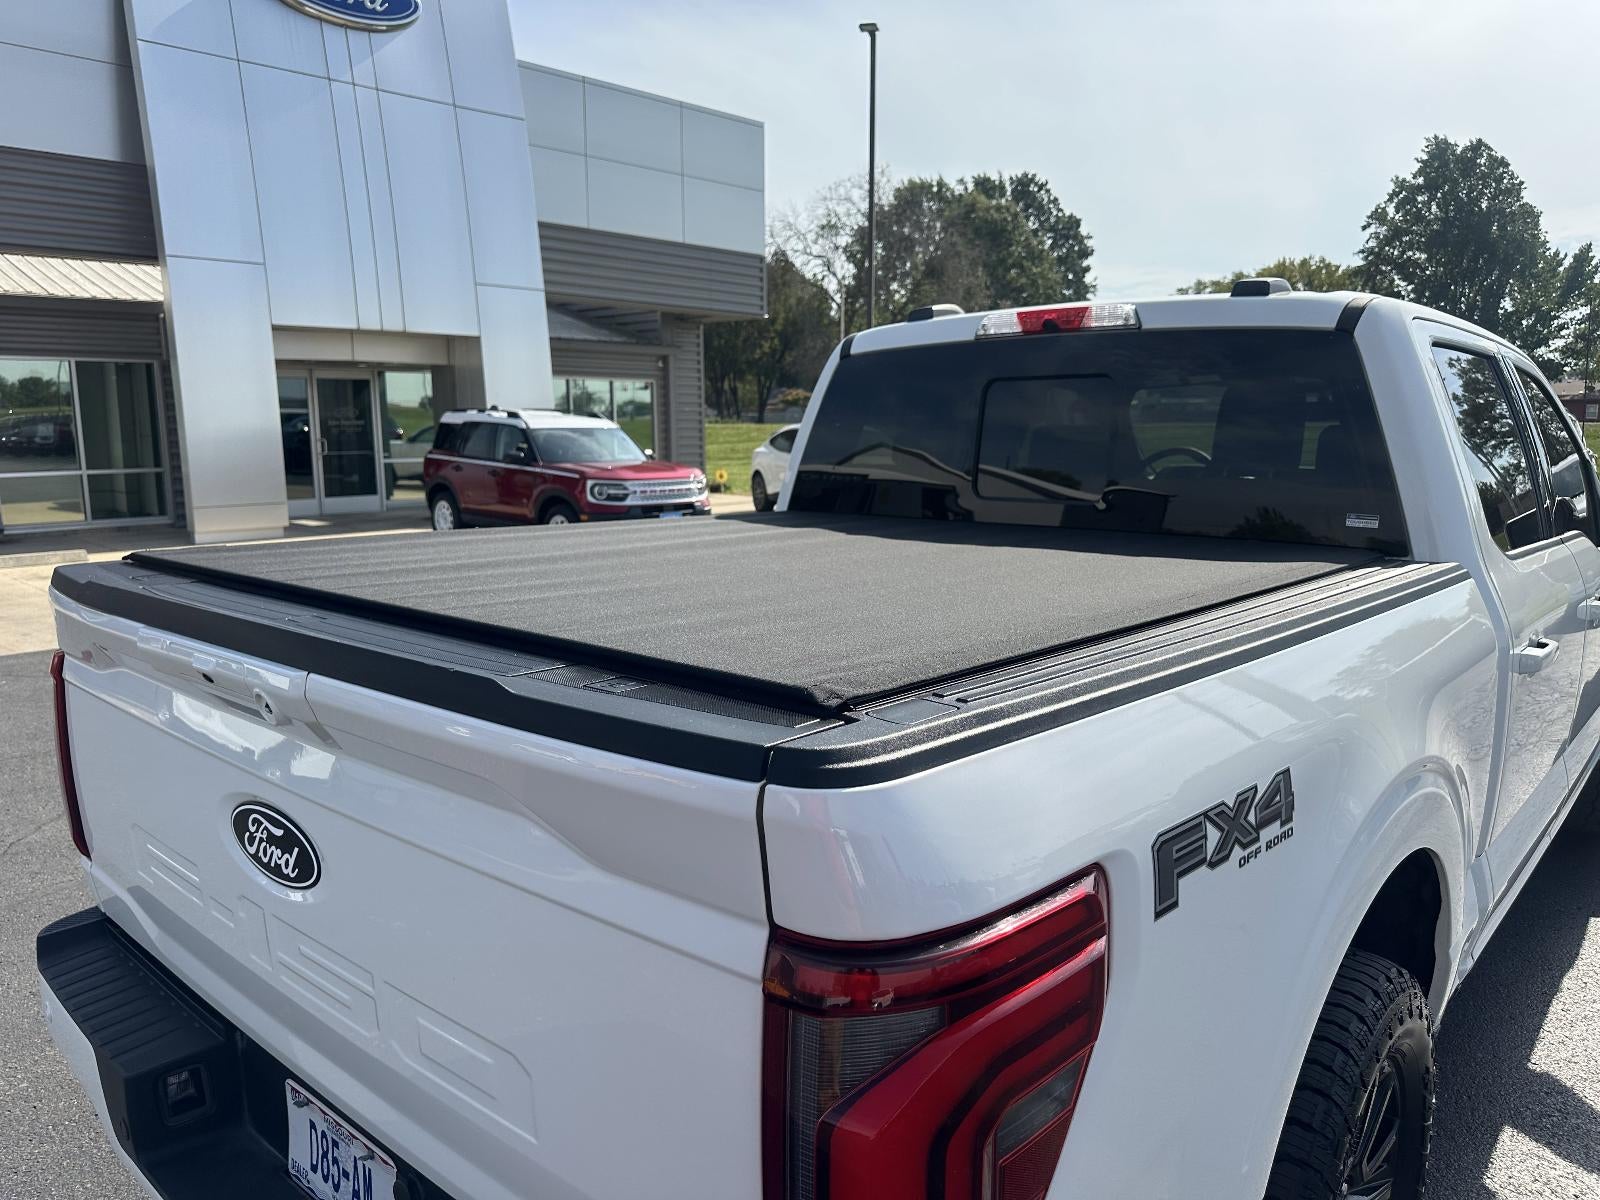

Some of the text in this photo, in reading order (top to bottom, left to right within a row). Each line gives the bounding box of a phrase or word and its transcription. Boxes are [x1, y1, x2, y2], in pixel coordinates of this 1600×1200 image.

[244, 813, 299, 878] Ford
[1151, 766, 1295, 922] FX4
[1238, 827, 1294, 869] OFF ROAD
[323, 1115, 354, 1146] MISSOURI
[291, 1158, 310, 1185] DEALER
[308, 1118, 374, 1200] D85-AM
